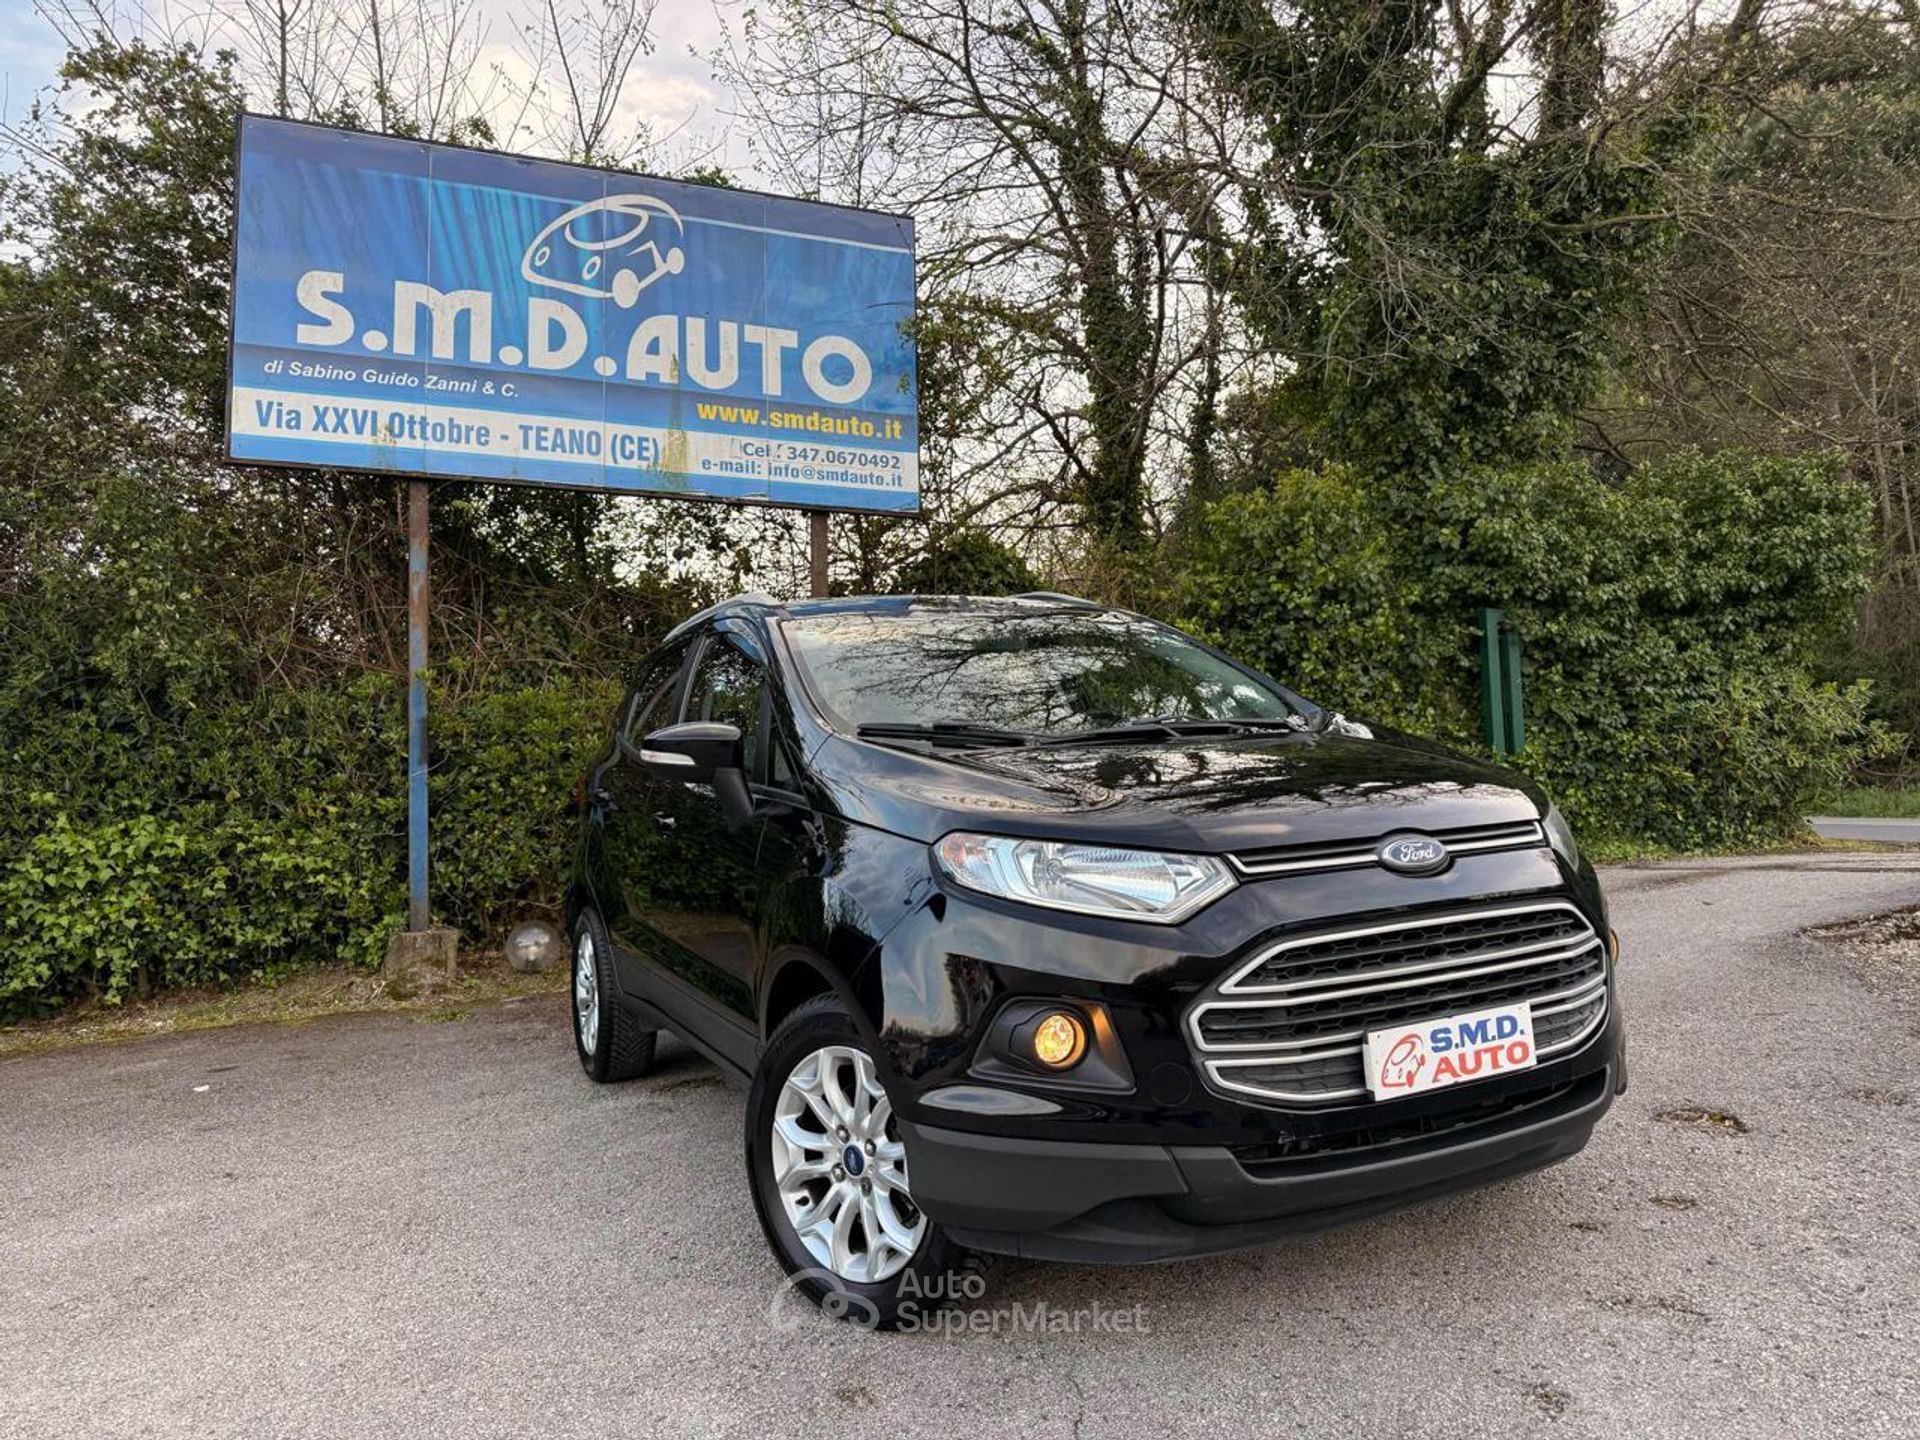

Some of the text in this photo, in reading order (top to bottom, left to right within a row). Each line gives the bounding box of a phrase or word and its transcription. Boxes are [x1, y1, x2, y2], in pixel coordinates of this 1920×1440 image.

[264, 360, 518, 397] di Sabino Guido Zanni & C.
[255, 400, 301, 432] Via
[312, 405, 377, 436] XXVI
[388, 412, 490, 445] Ottobre
[518, 424, 600, 456] TEANO
[610, 433, 659, 464] (CE)
[697, 403, 903, 440] www.smdauto.it
[702, 457, 903, 487] e-mail: info@smdauto.it
[787, 446, 900, 469] 347.0670492
[1400, 840, 1435, 861] Ford
[1430, 1015, 1525, 1052] S.M.D.
[1432, 1041, 1530, 1083] AUTO
